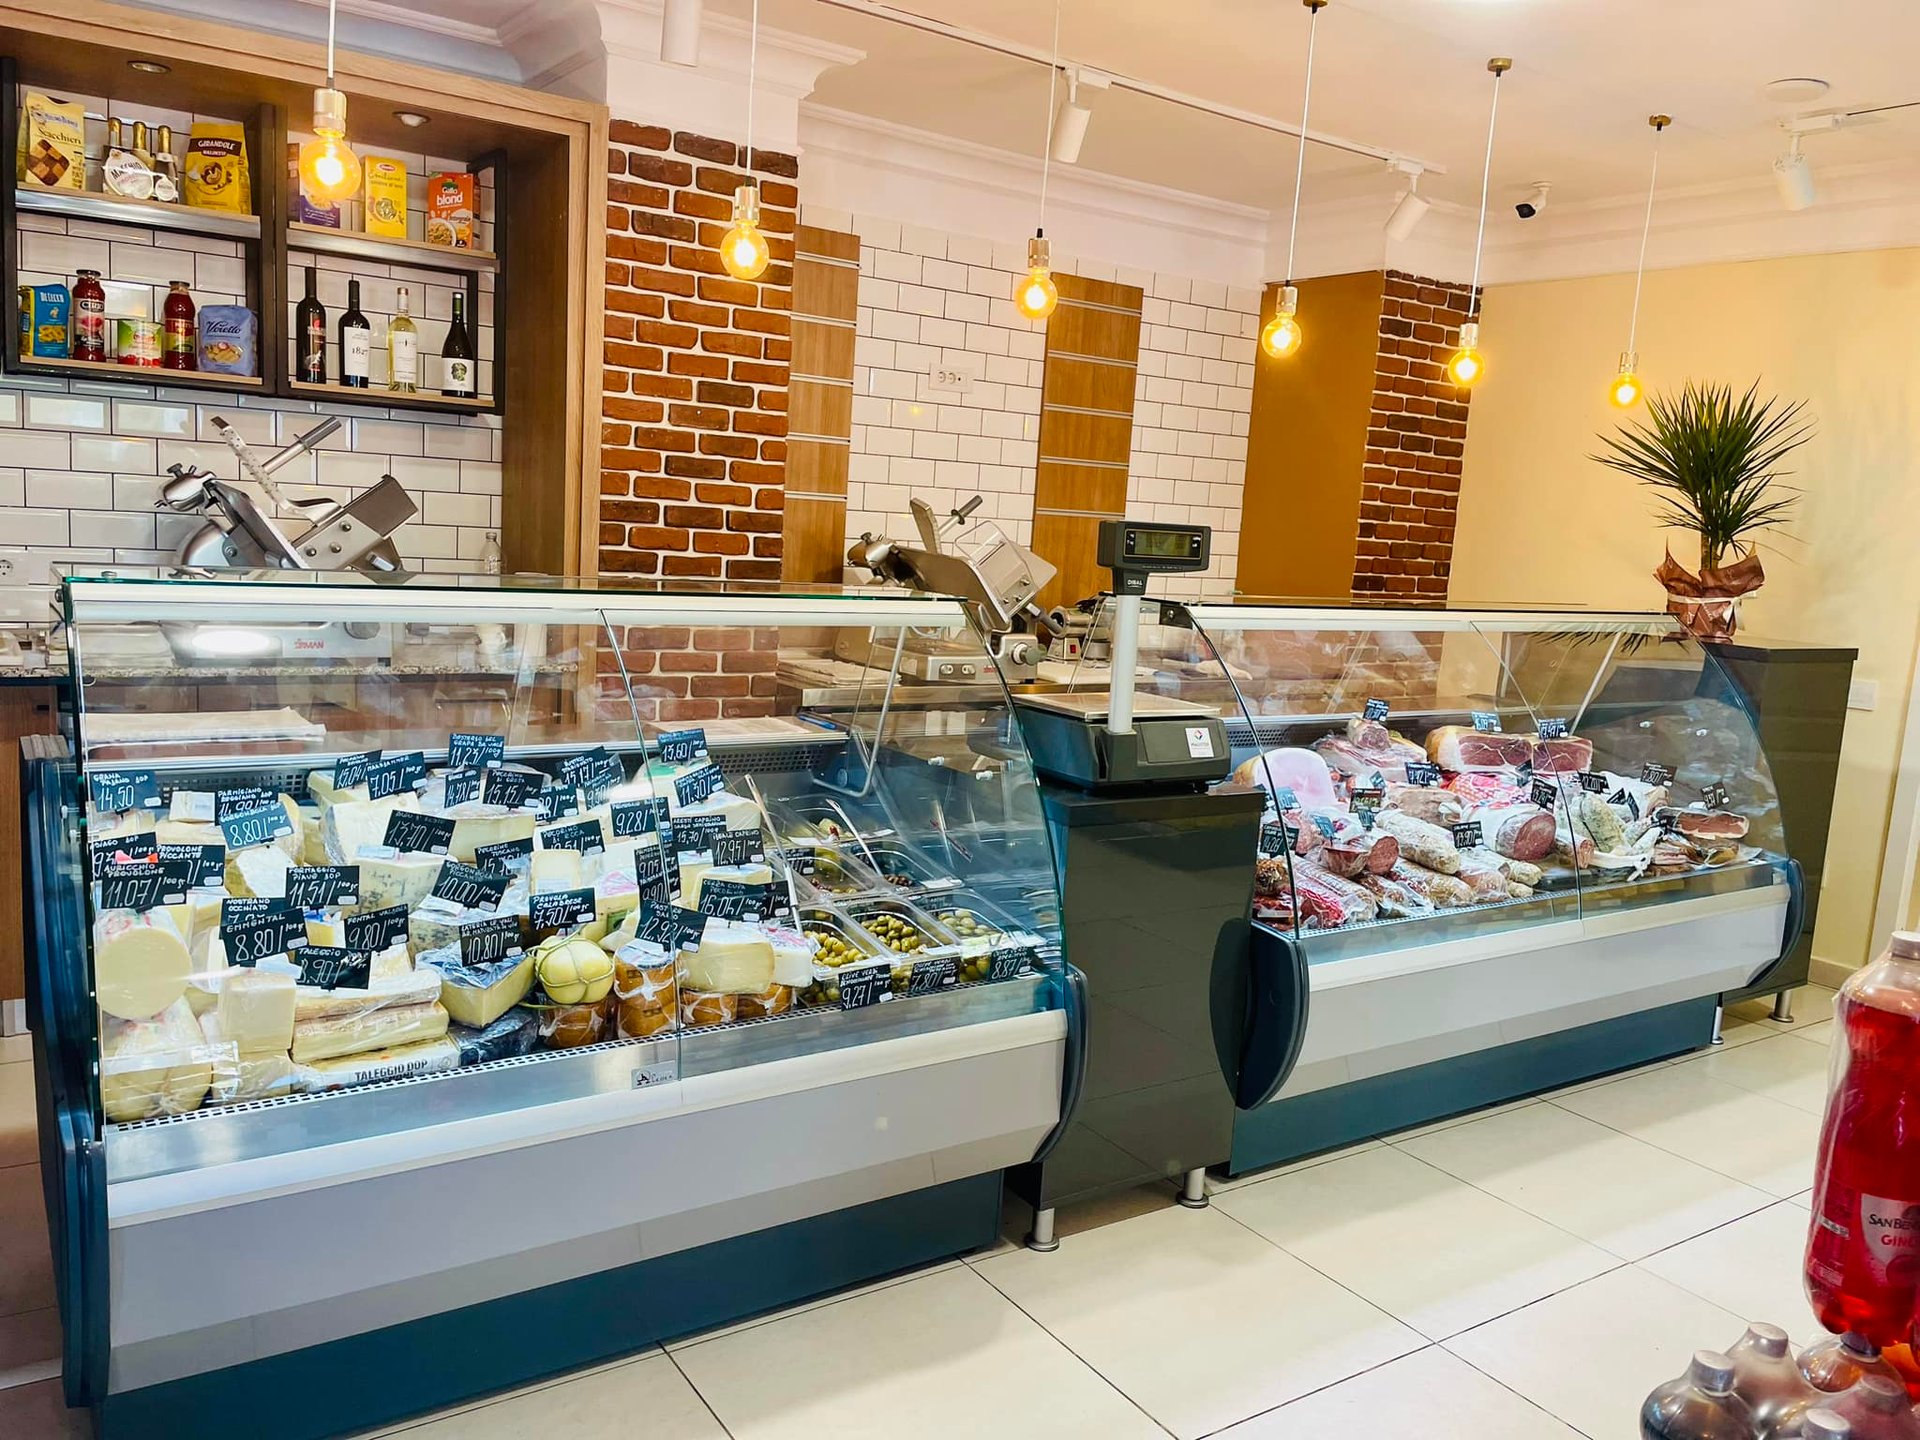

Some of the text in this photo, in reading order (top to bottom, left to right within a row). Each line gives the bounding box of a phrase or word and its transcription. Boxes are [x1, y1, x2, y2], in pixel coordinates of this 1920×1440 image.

[436, 192, 464, 206] blond
[156, 845, 203, 853] PROVOLONE
[108, 867, 166, 878] PROVOLONE
[226, 913, 286, 933] EMMENTAL
[299, 948, 341, 957] TALEGGIO
[354, 1062, 405, 1081] TALEGGIO
